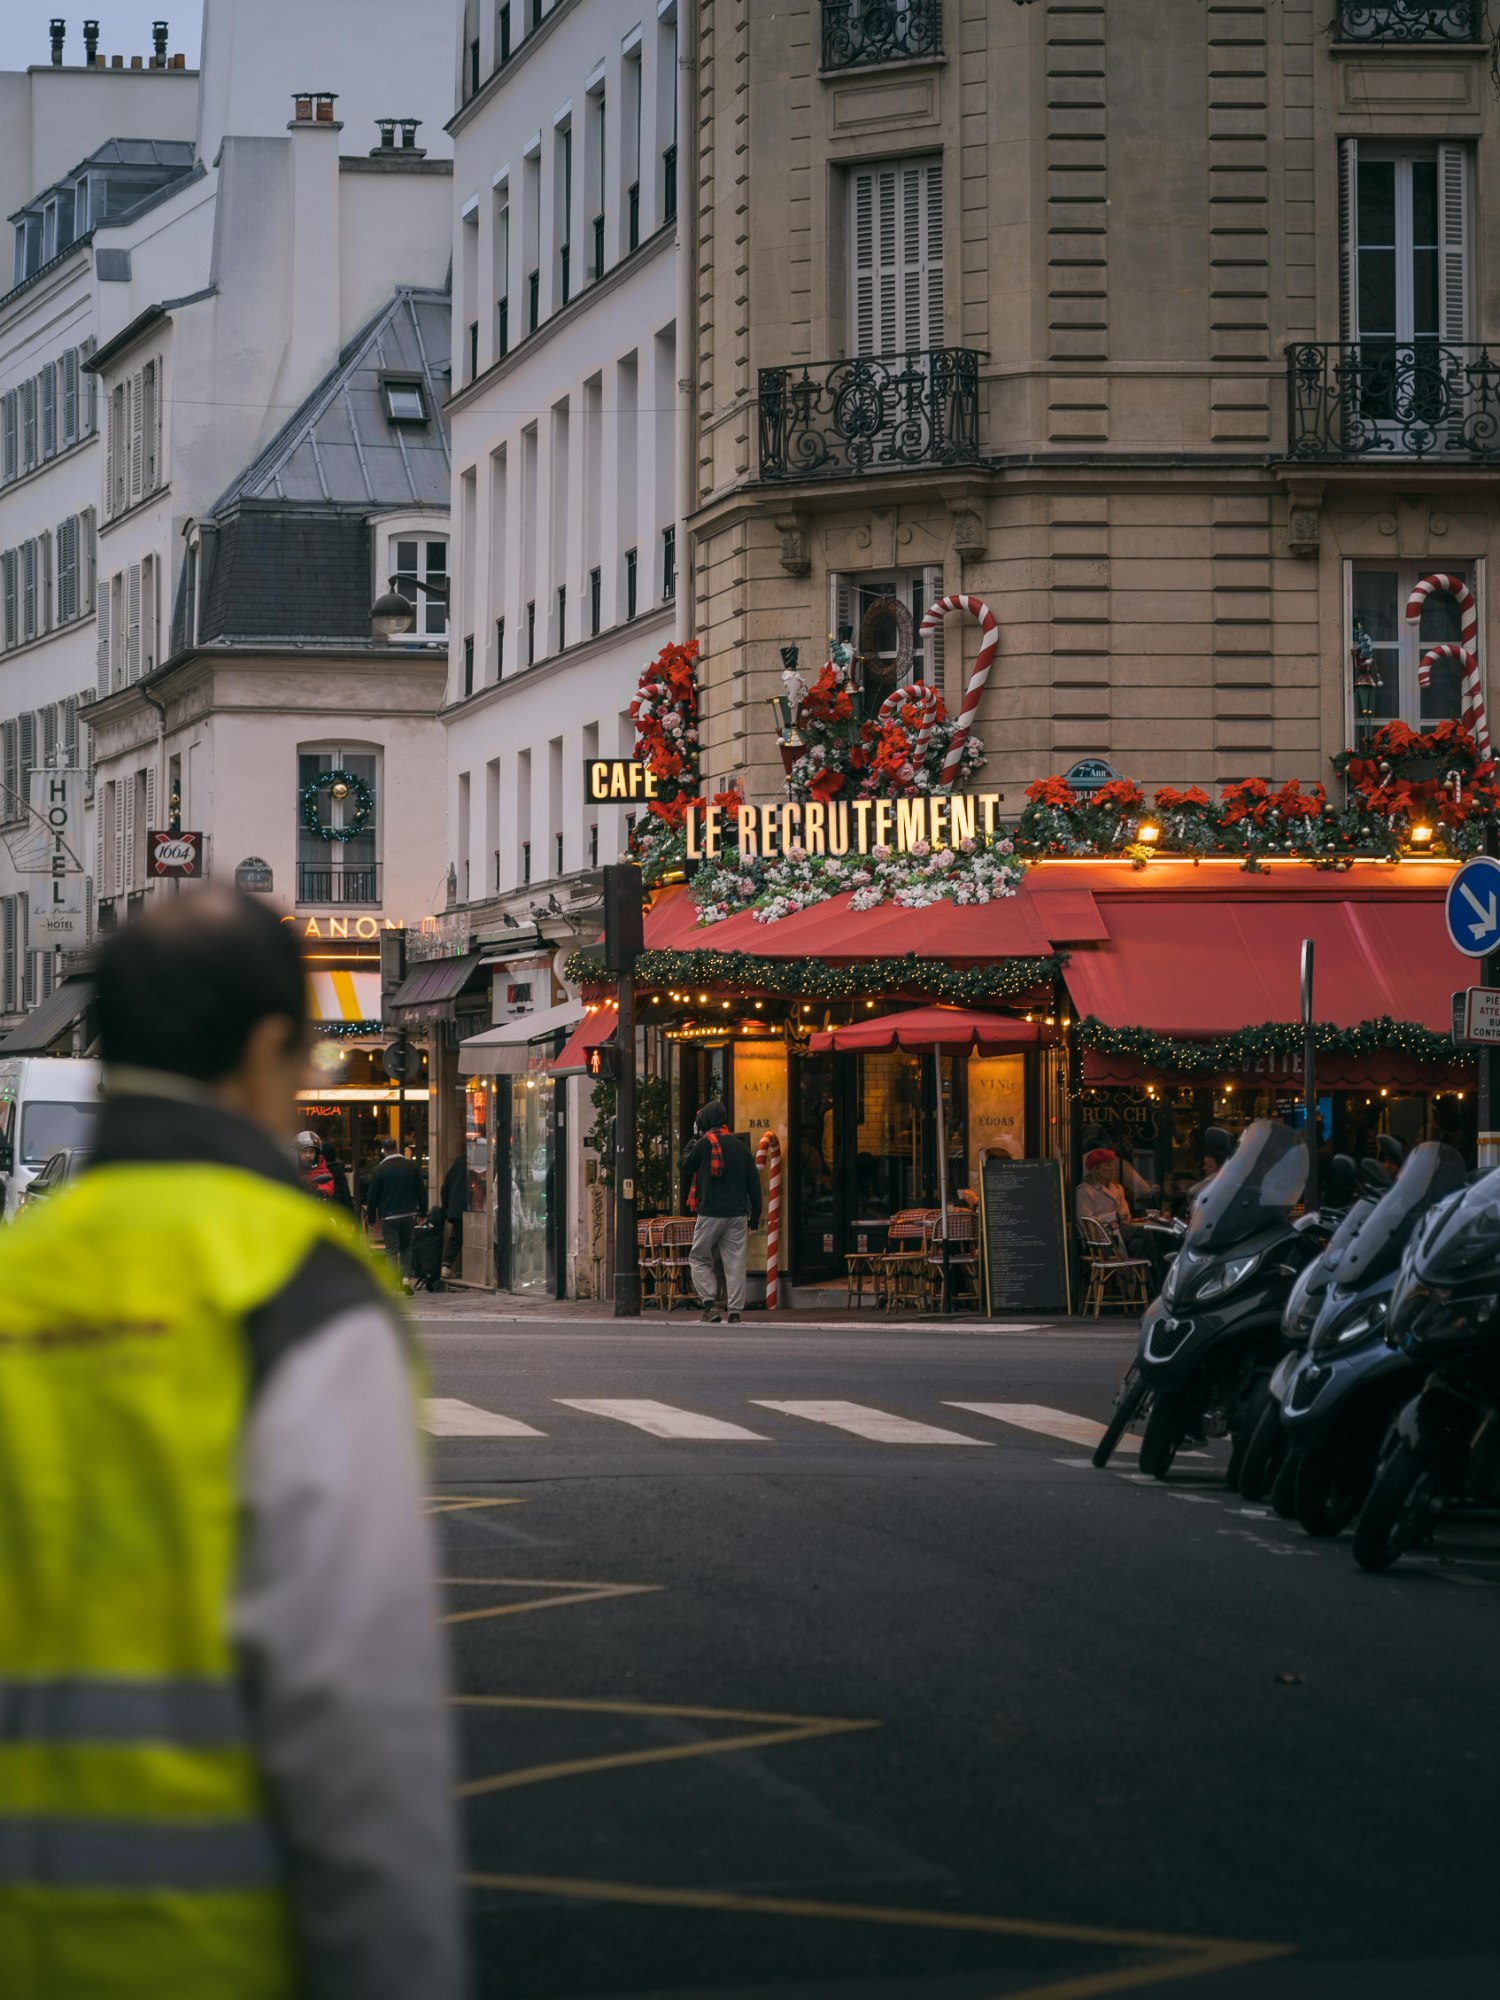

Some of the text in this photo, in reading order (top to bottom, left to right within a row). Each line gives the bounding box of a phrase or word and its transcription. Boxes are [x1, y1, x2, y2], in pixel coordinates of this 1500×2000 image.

[592, 762, 658, 798] CAFE
[686, 793, 999, 860] LE RECRUTEMENT
[159, 844, 190, 860] 1664
[47, 921, 74, 929] HOTEL
[280, 916, 403, 939] ANON
[1480, 1007, 1500, 1016] ATTE
[1082, 1107, 1147, 1122] RUNCH
